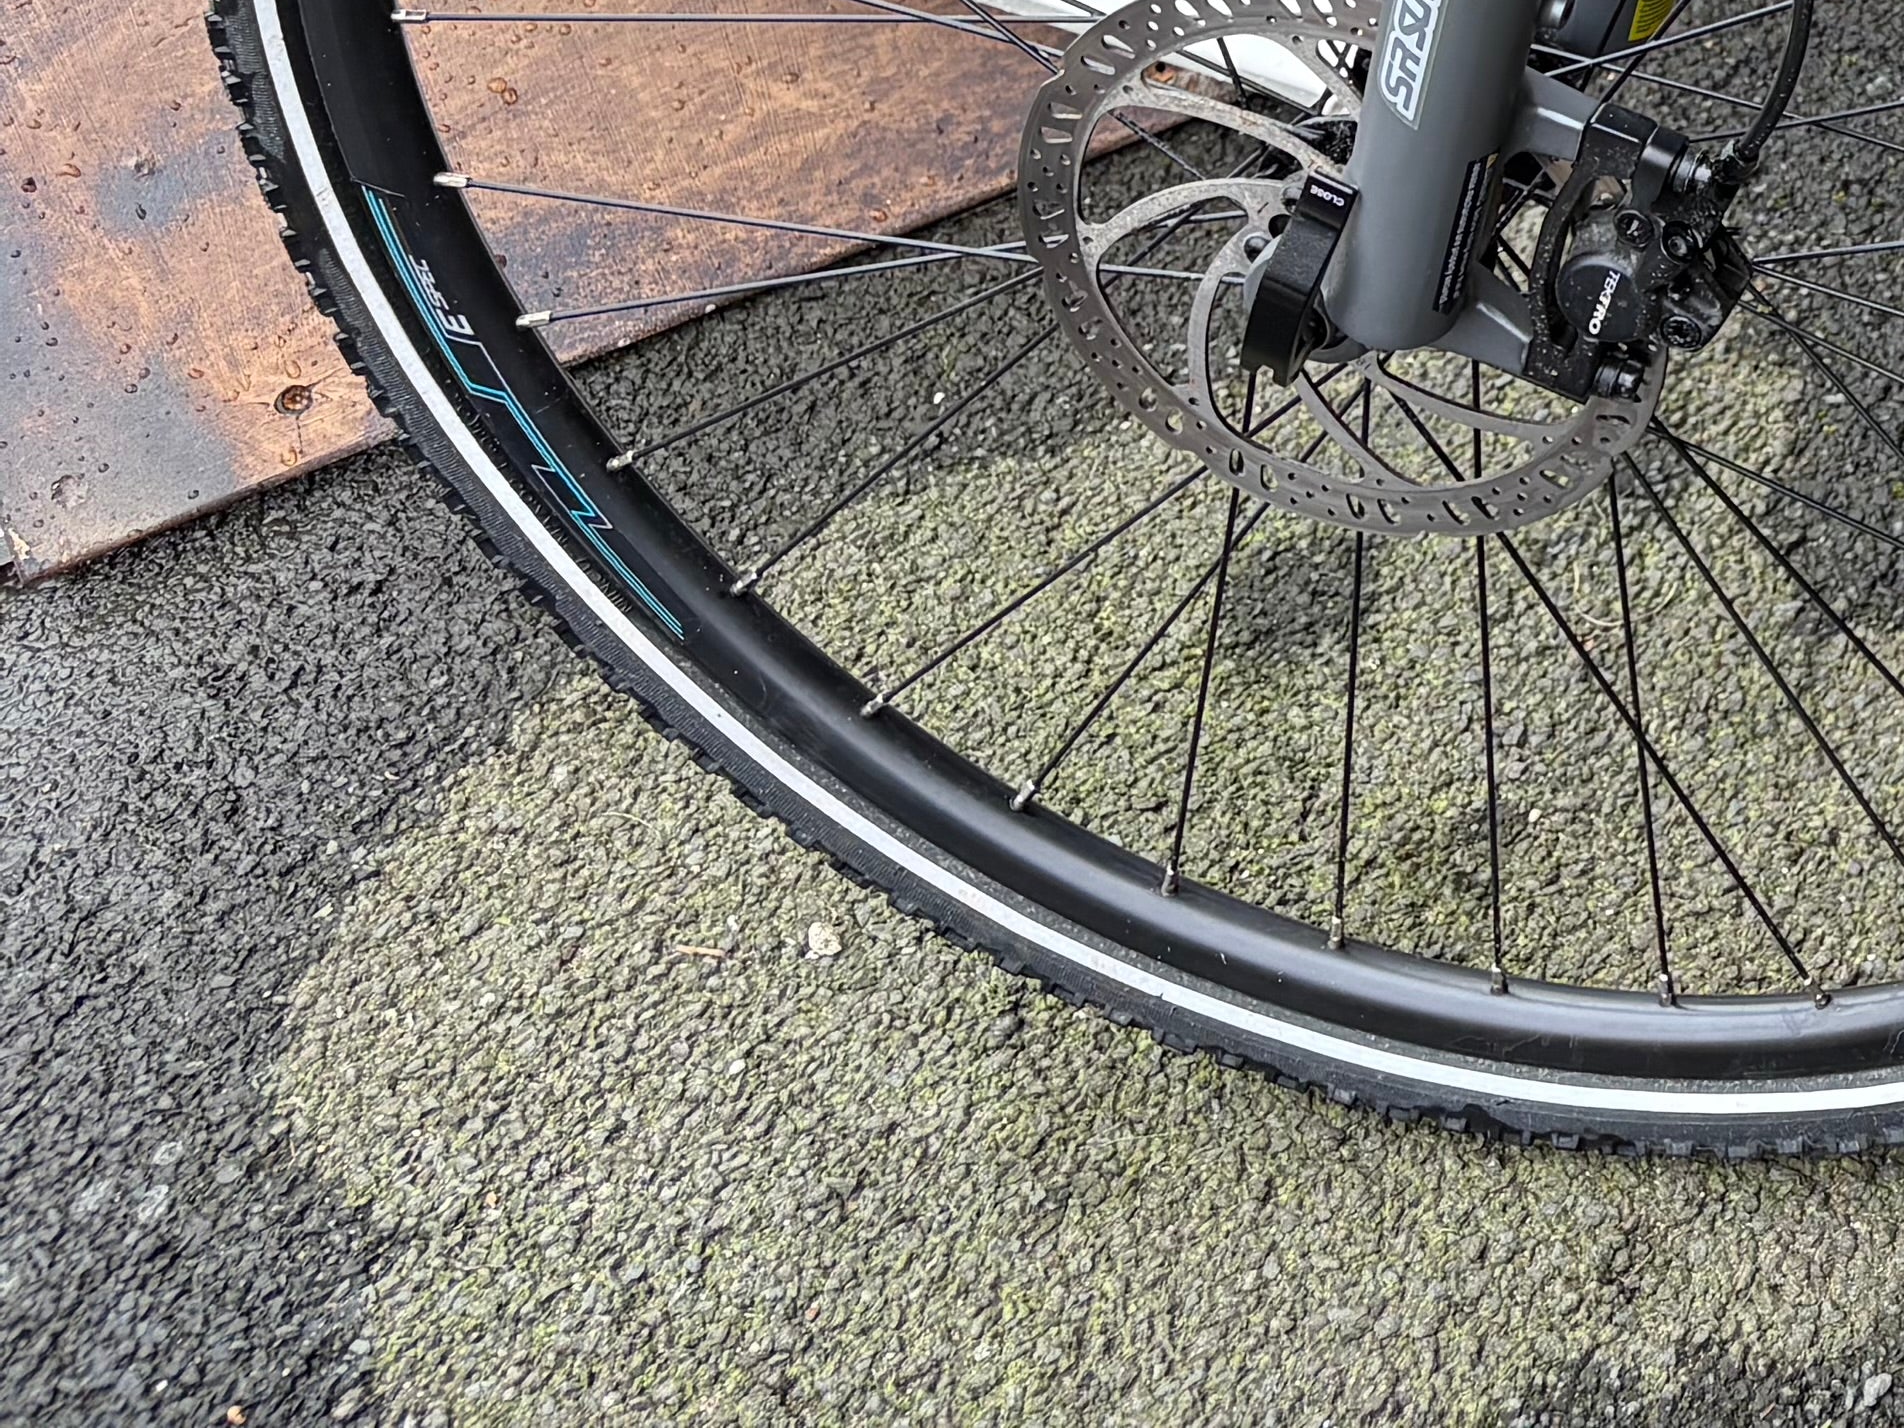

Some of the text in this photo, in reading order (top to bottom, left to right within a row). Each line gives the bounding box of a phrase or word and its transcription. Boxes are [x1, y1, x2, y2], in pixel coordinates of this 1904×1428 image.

[1309, 184, 1345, 207] CLOSE
[1588, 270, 1621, 335] TEKTRO
[435, 308, 475, 336] E
